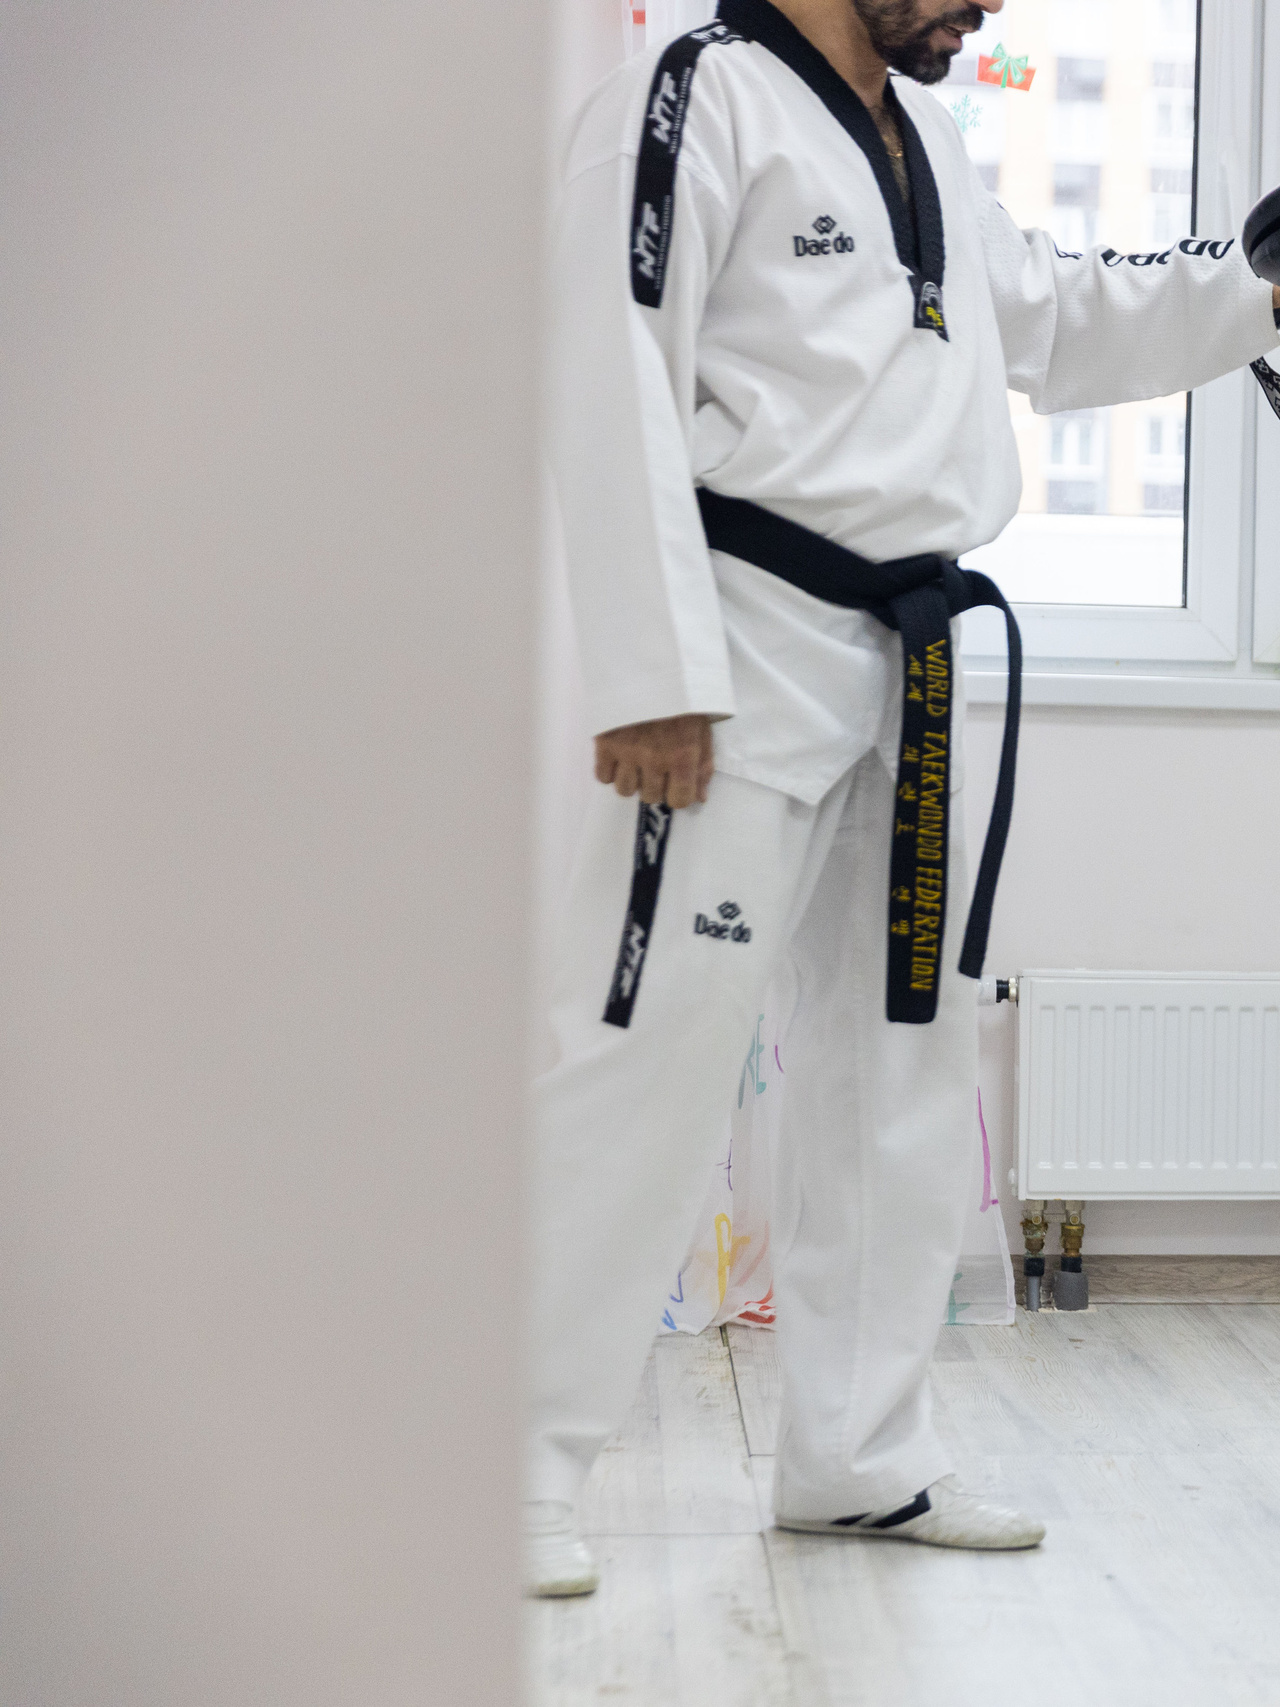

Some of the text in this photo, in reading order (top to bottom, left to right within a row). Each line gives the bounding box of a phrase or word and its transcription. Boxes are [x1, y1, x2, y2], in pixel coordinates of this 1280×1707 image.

[647, 71, 678, 144] WTF
[634, 202, 661, 279] WTF
[910, 639, 949, 991] WORLD TAEKWONDO FEDERATION
